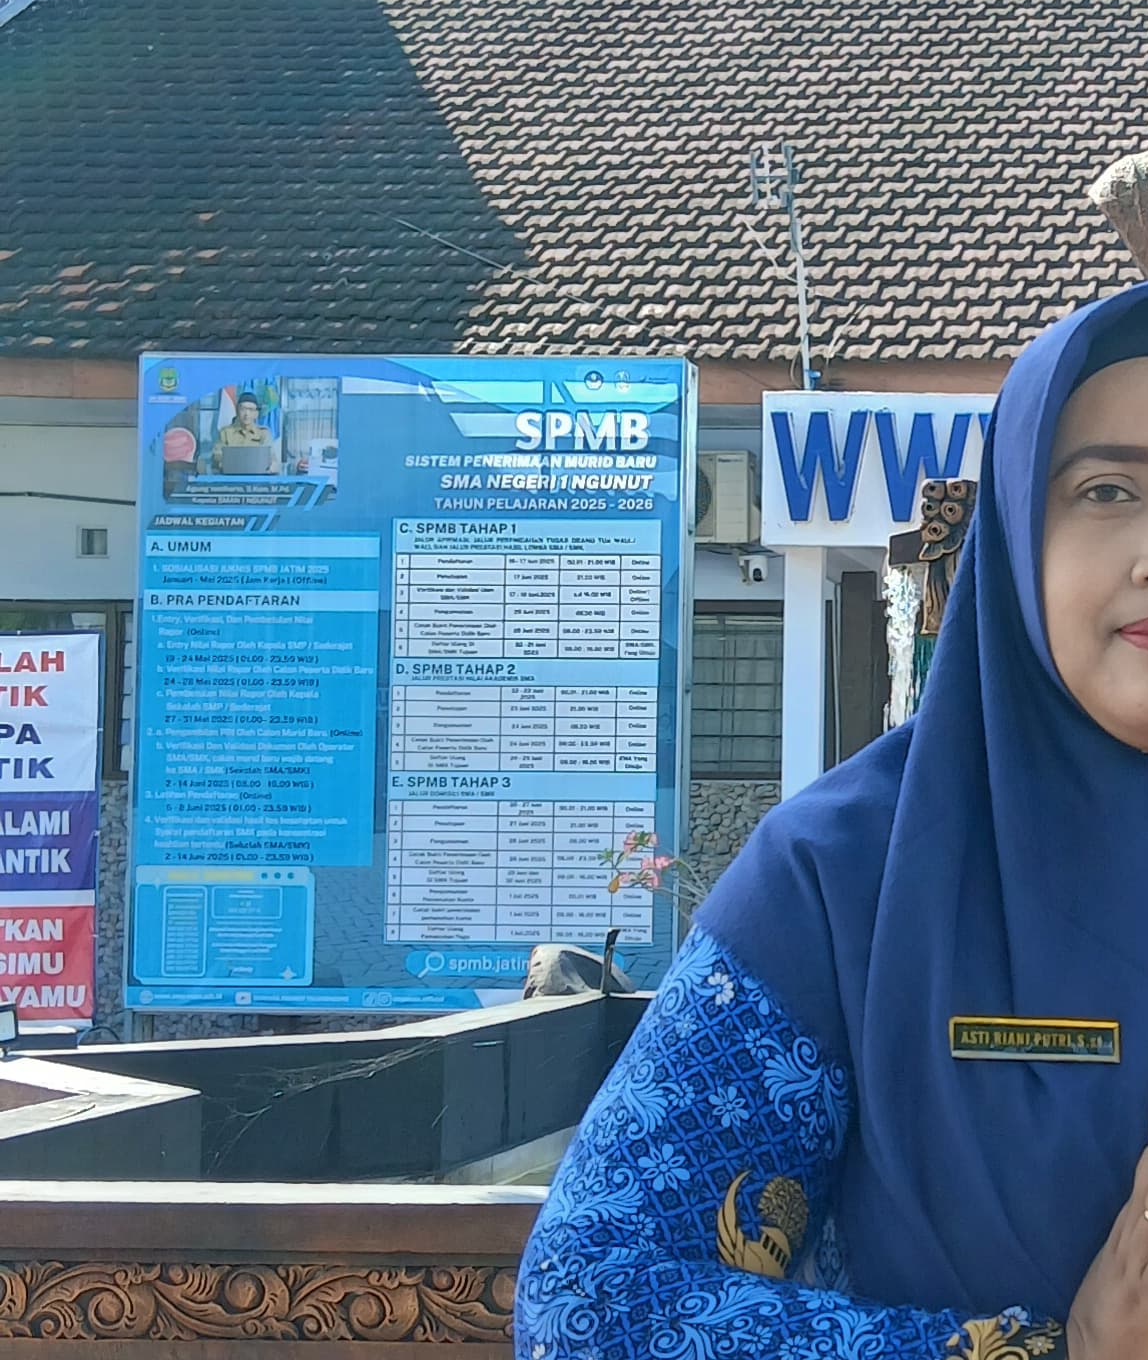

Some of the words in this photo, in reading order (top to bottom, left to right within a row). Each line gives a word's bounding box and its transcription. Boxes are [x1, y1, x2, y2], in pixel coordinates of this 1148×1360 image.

[515, 410, 649, 451] SPMB
[405, 456, 461, 468] SISTEM
[464, 456, 562, 468] PENERIMAAN
[564, 456, 614, 468] MURID
[616, 456, 656, 468] BARU
[770, 409, 993, 522] ww
[440, 475, 482, 490] SMA
[487, 475, 556, 490] NEGERI
[571, 475, 653, 490] NGUNUT
[435, 498, 485, 510] TAHUN
[487, 498, 568, 510] PELAJARAN
[571, 498, 607, 510] 2025
[618, 498, 653, 510] 2026
[399, 523, 412, 534] C.
[416, 523, 456, 534] SPMB
[460, 523, 508, 534] TAHAP
[511, 523, 516, 534] 1
[151, 542, 163, 552] A.
[168, 542, 212, 552] UMUM
[151, 595, 162, 605] B.
[166, 595, 194, 605] PRA
[198, 595, 300, 605] PENDAFTARAN
[396, 664, 409, 675] D.
[412, 664, 452, 675] SPMB
[456, 664, 504, 675] TAHAP
[507, 664, 515, 675] 2
[392, 777, 403, 788] E.
[407, 777, 448, 788] SPMB
[451, 777, 499, 788] TAHAP
[502, 777, 511, 788] 3
[0, 811, 70, 835] LAMI
[0, 848, 71, 873] NTIK
[0, 918, 63, 941] KAN
[0, 985, 86, 1008] YAMU
[961, 1031, 989, 1044] ASTI
[994, 1032, 1030, 1045] RIANI
